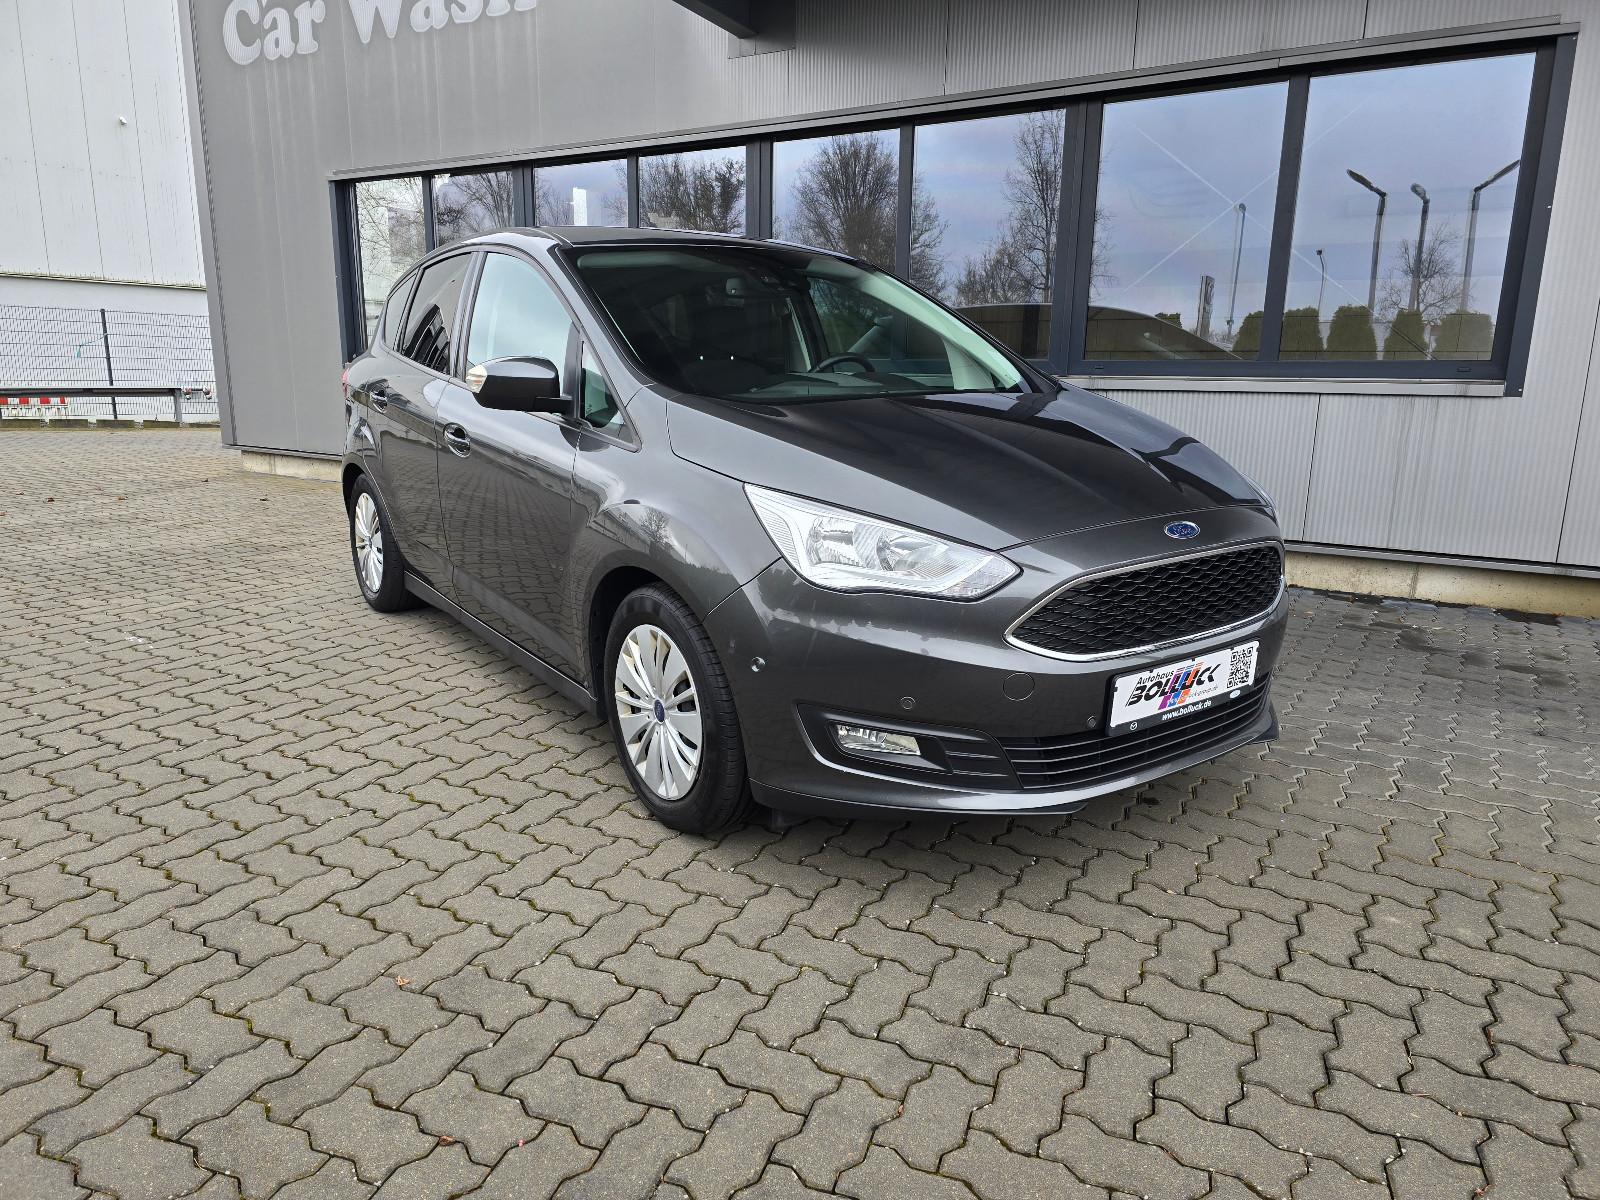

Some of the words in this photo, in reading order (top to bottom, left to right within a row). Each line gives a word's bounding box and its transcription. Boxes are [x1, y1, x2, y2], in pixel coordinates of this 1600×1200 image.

[222, 0, 326, 65] Car
[349, 0, 537, 44] Was
[1137, 670, 1174, 685] Autohaus
[1162, 700, 1212, 721] www.bolluck.de
